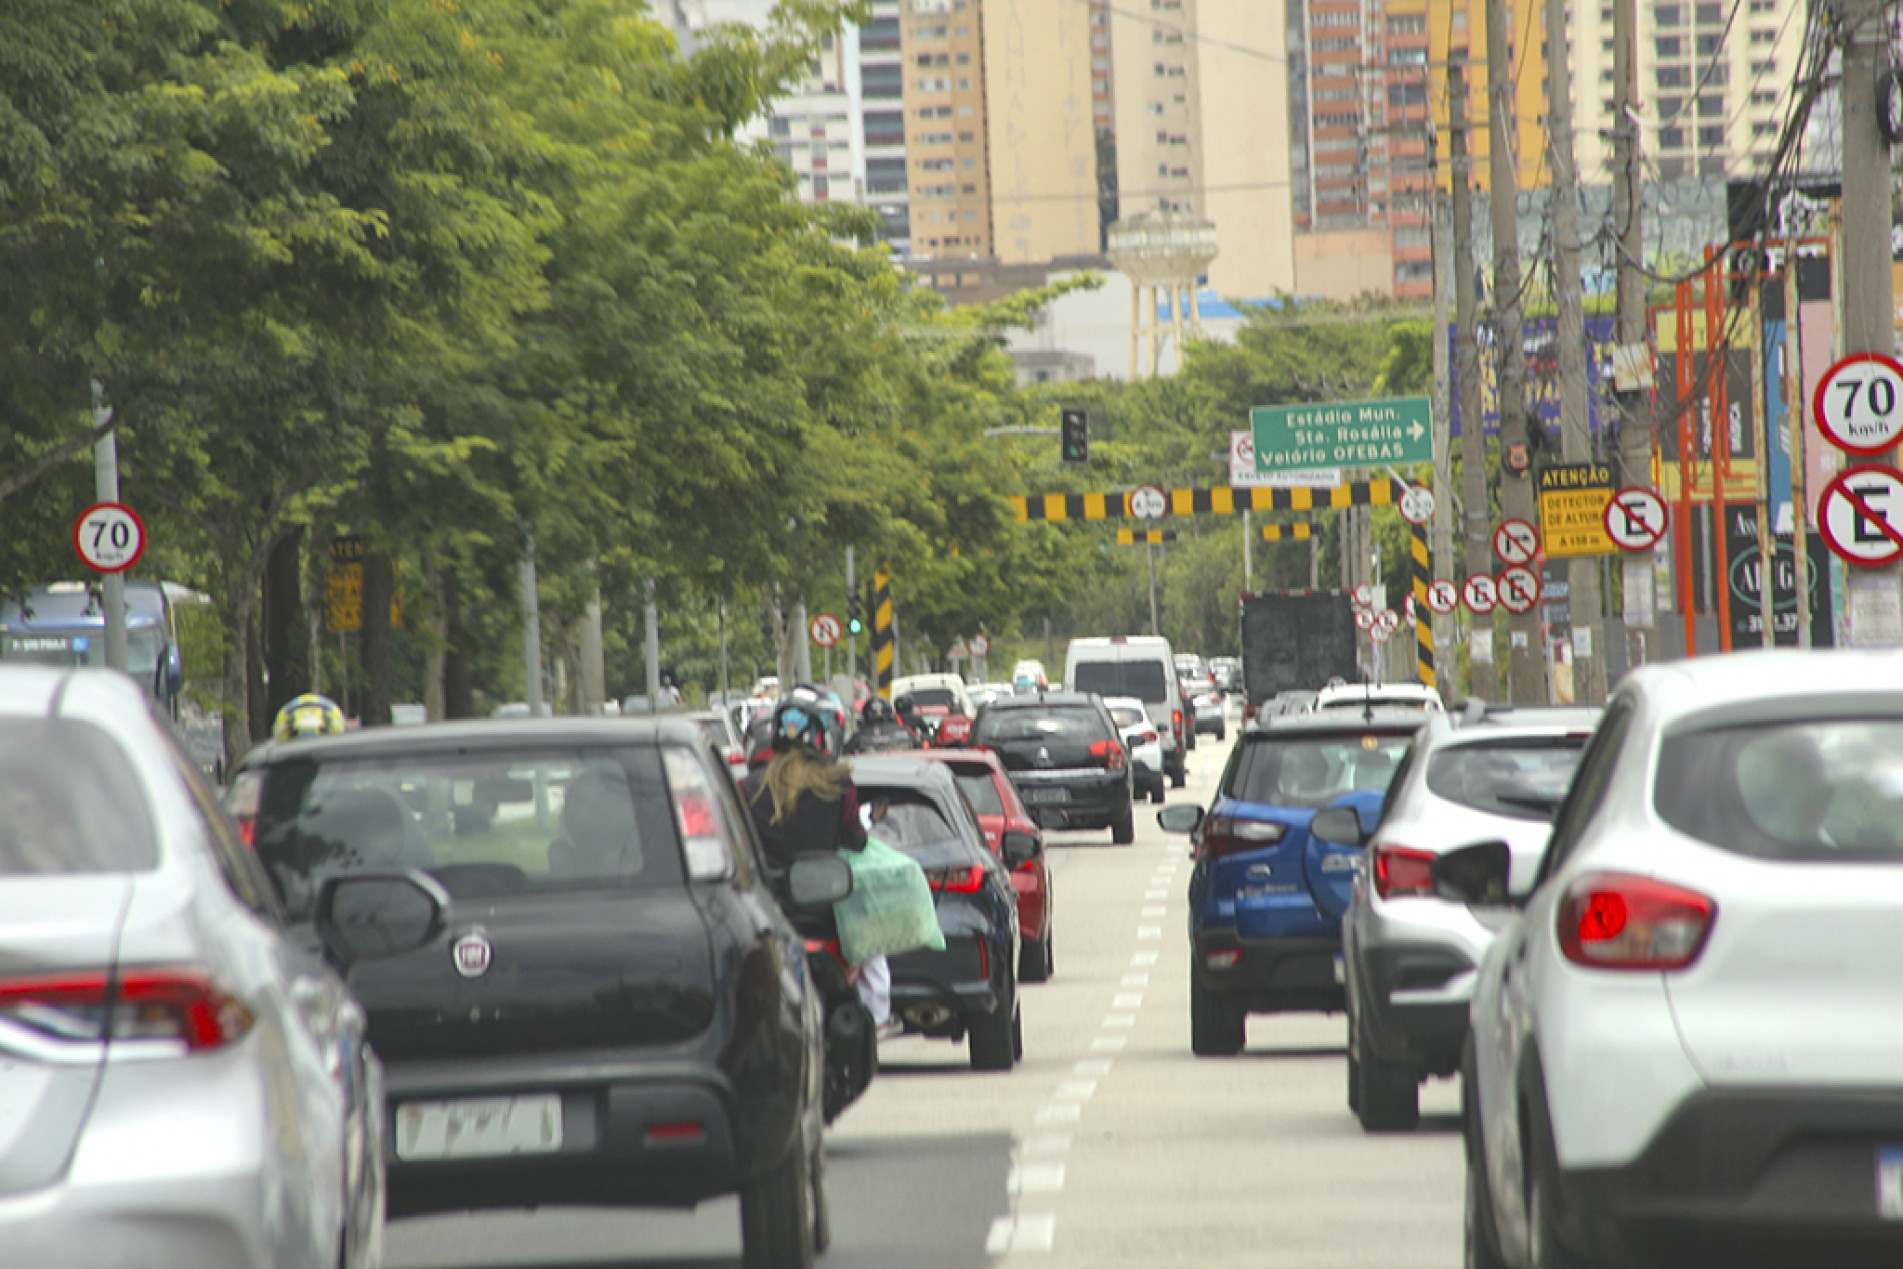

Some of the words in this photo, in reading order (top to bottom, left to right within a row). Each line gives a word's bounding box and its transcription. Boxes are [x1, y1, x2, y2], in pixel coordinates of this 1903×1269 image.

[1836, 378, 1895, 418] 70
[1286, 409, 1352, 428] Estádio
[1359, 407, 1401, 423] Mun.
[1294, 429, 1330, 446] Sta.
[1337, 424, 1402, 443] Rosália
[1848, 421, 1889, 437] km/h
[1261, 447, 1326, 466] Velório
[1333, 442, 1404, 461] OFEBAS
[1542, 464, 1610, 487] ATENÇÃO
[1548, 495, 1605, 509] DETECTOR
[1548, 512, 1561, 526] DE
[88, 520, 130, 549] 70
